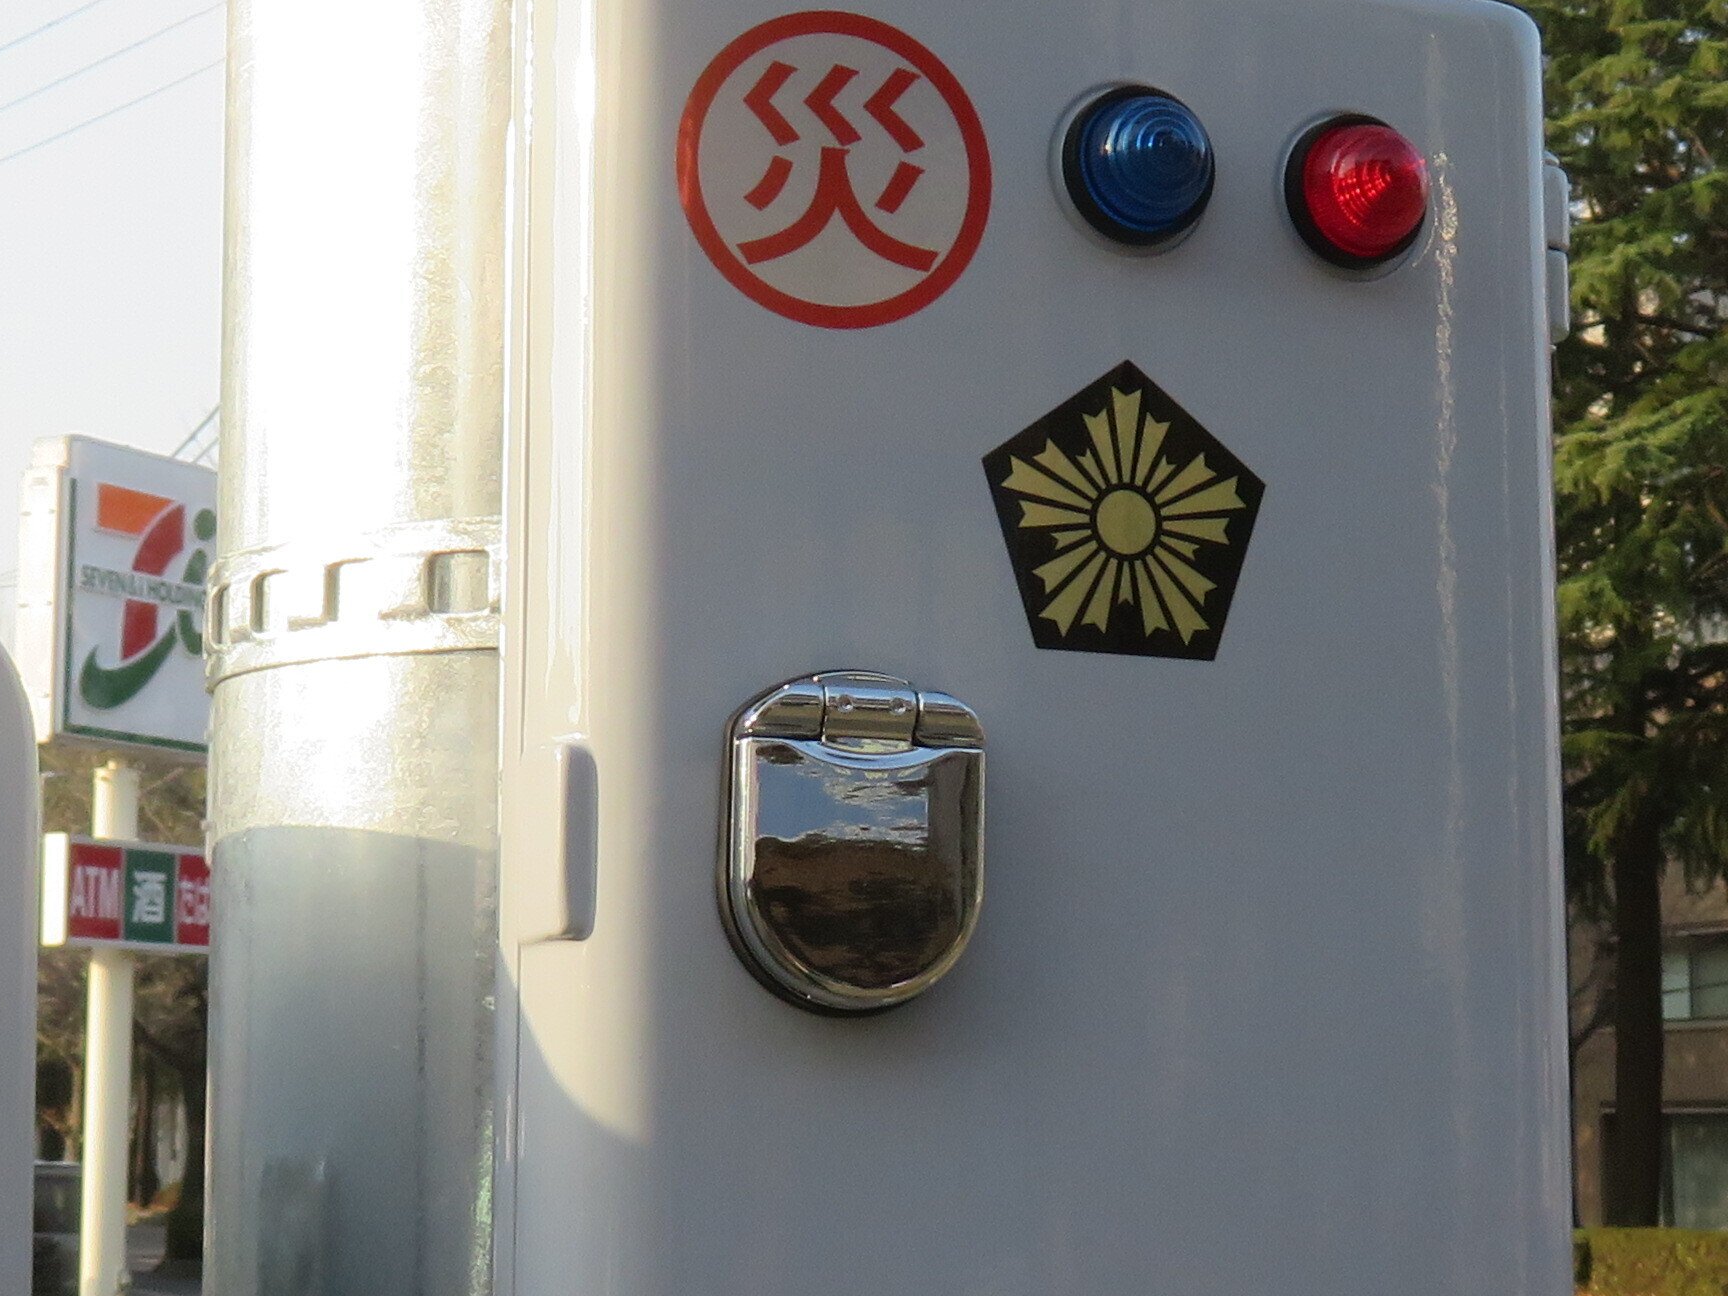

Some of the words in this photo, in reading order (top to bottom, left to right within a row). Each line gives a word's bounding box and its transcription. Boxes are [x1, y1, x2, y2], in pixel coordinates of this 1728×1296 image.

[736, 60, 939, 273] 災
[71, 865, 120, 919] ATM
[131, 870, 167, 924] 酒
